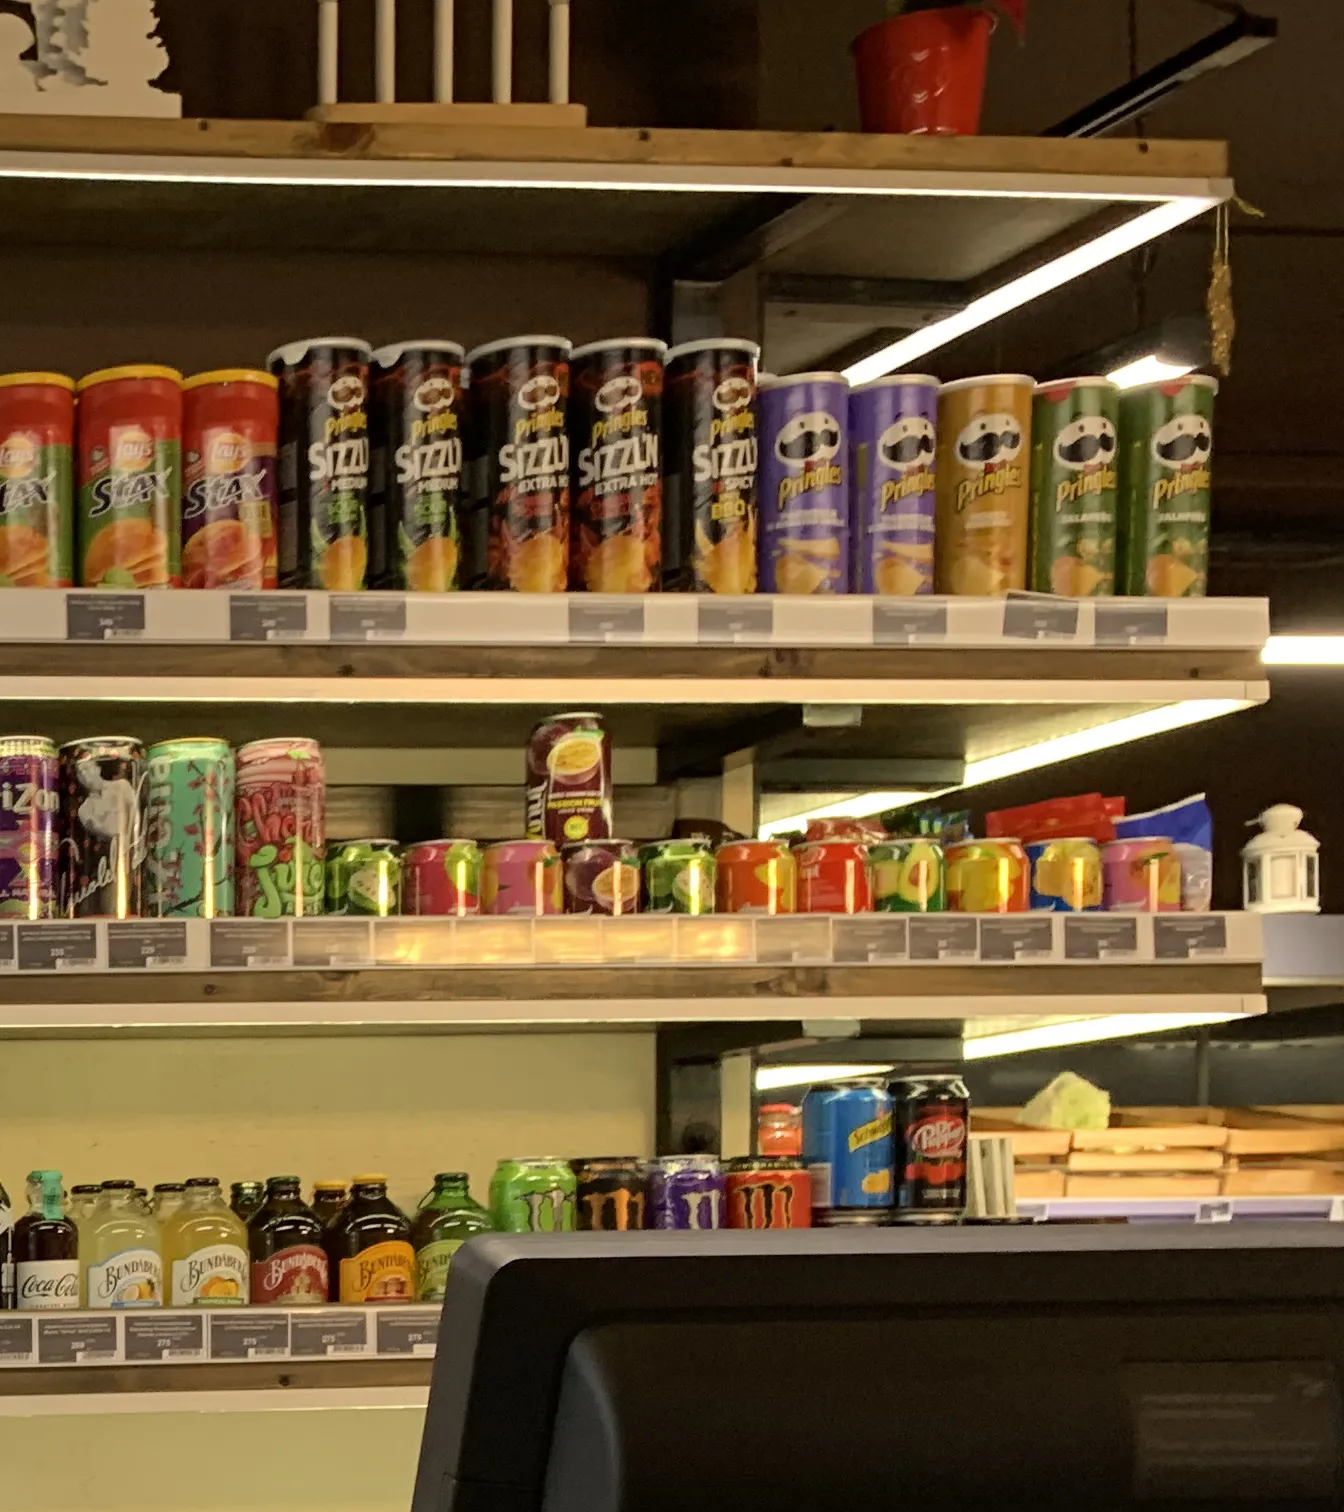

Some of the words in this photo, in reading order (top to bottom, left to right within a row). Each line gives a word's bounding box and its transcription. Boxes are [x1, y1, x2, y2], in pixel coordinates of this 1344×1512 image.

[592, 408, 649, 447] Pringles
[594, 475, 637, 496] EXTRA
[777, 461, 843, 512] Pringles
[955, 461, 1022, 512] Pringles
